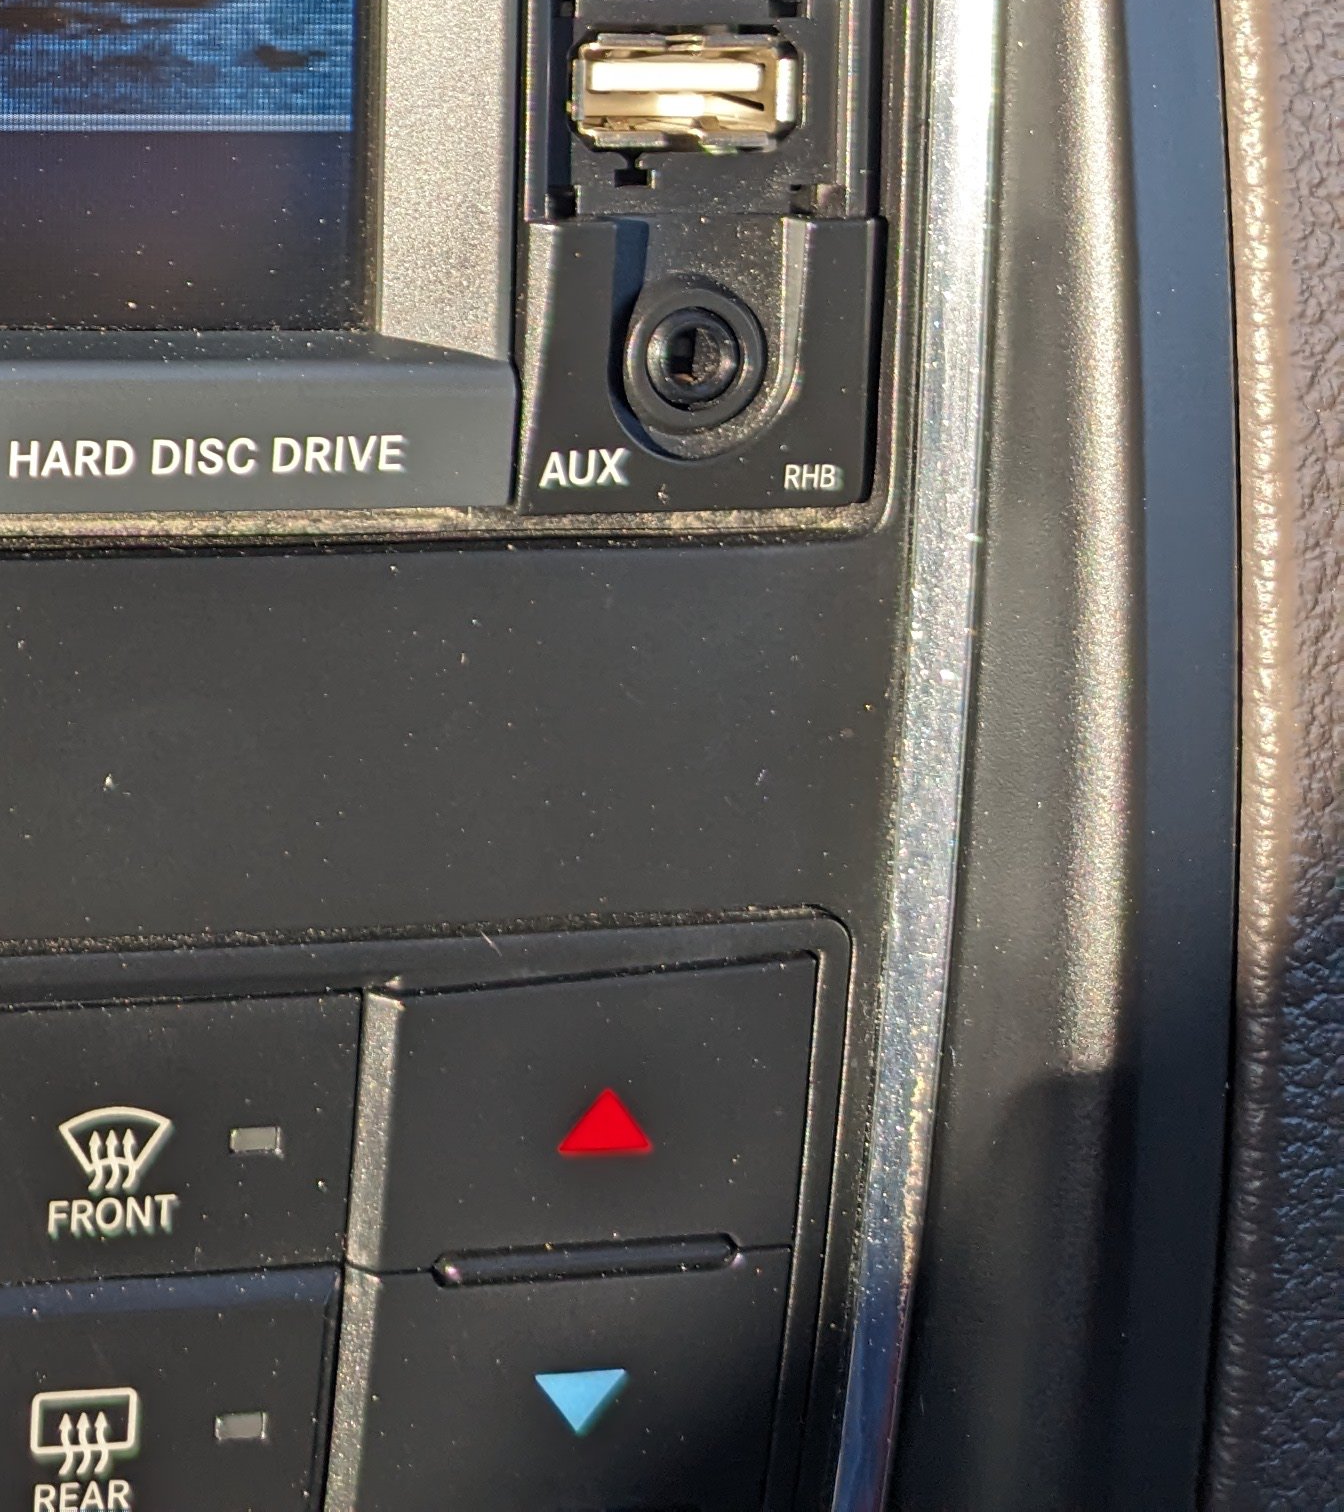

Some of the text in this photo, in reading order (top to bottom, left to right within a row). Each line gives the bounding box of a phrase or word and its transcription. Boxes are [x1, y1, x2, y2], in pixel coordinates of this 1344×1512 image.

[7, 435, 404, 478] HARD DISC DRIVE
[539, 448, 626, 489] AUX
[784, 463, 841, 491] RHB
[47, 1193, 176, 1235] FRONT
[33, 1479, 129, 1512] REAR
